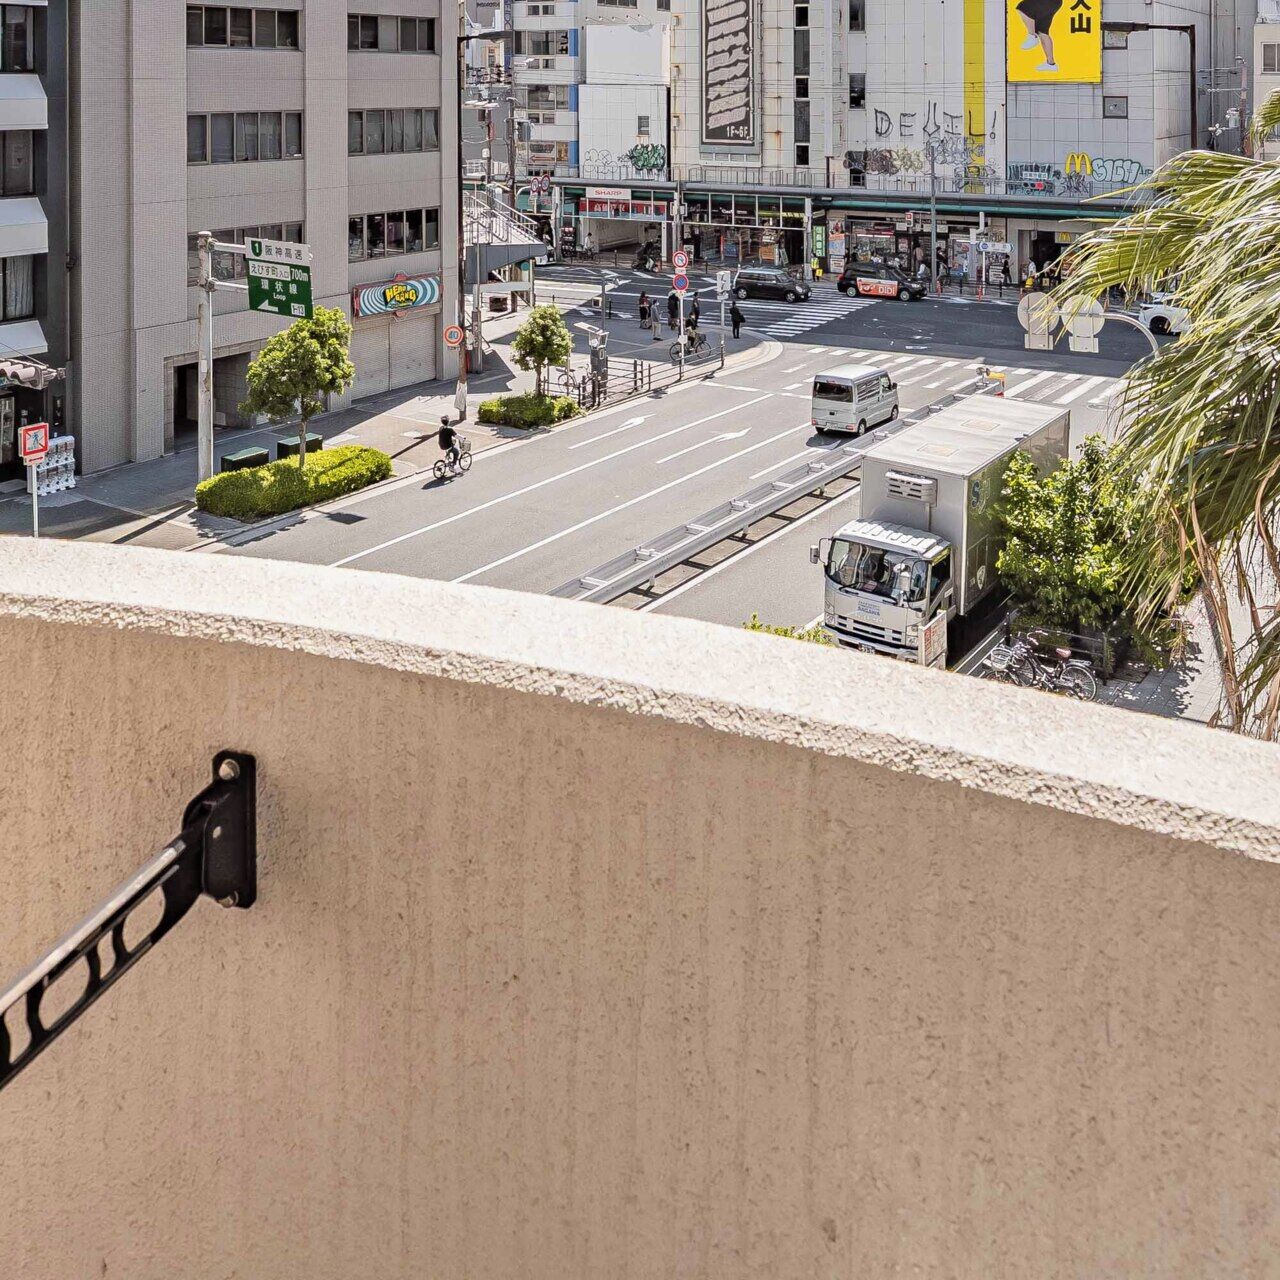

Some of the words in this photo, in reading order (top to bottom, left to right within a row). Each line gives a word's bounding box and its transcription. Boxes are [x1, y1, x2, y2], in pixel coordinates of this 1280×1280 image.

[264, 245, 303, 261] 阪神高速
[291, 268, 309, 282] 700m
[260, 279, 298, 295] 環状線
[273, 292, 287, 301] Loop
